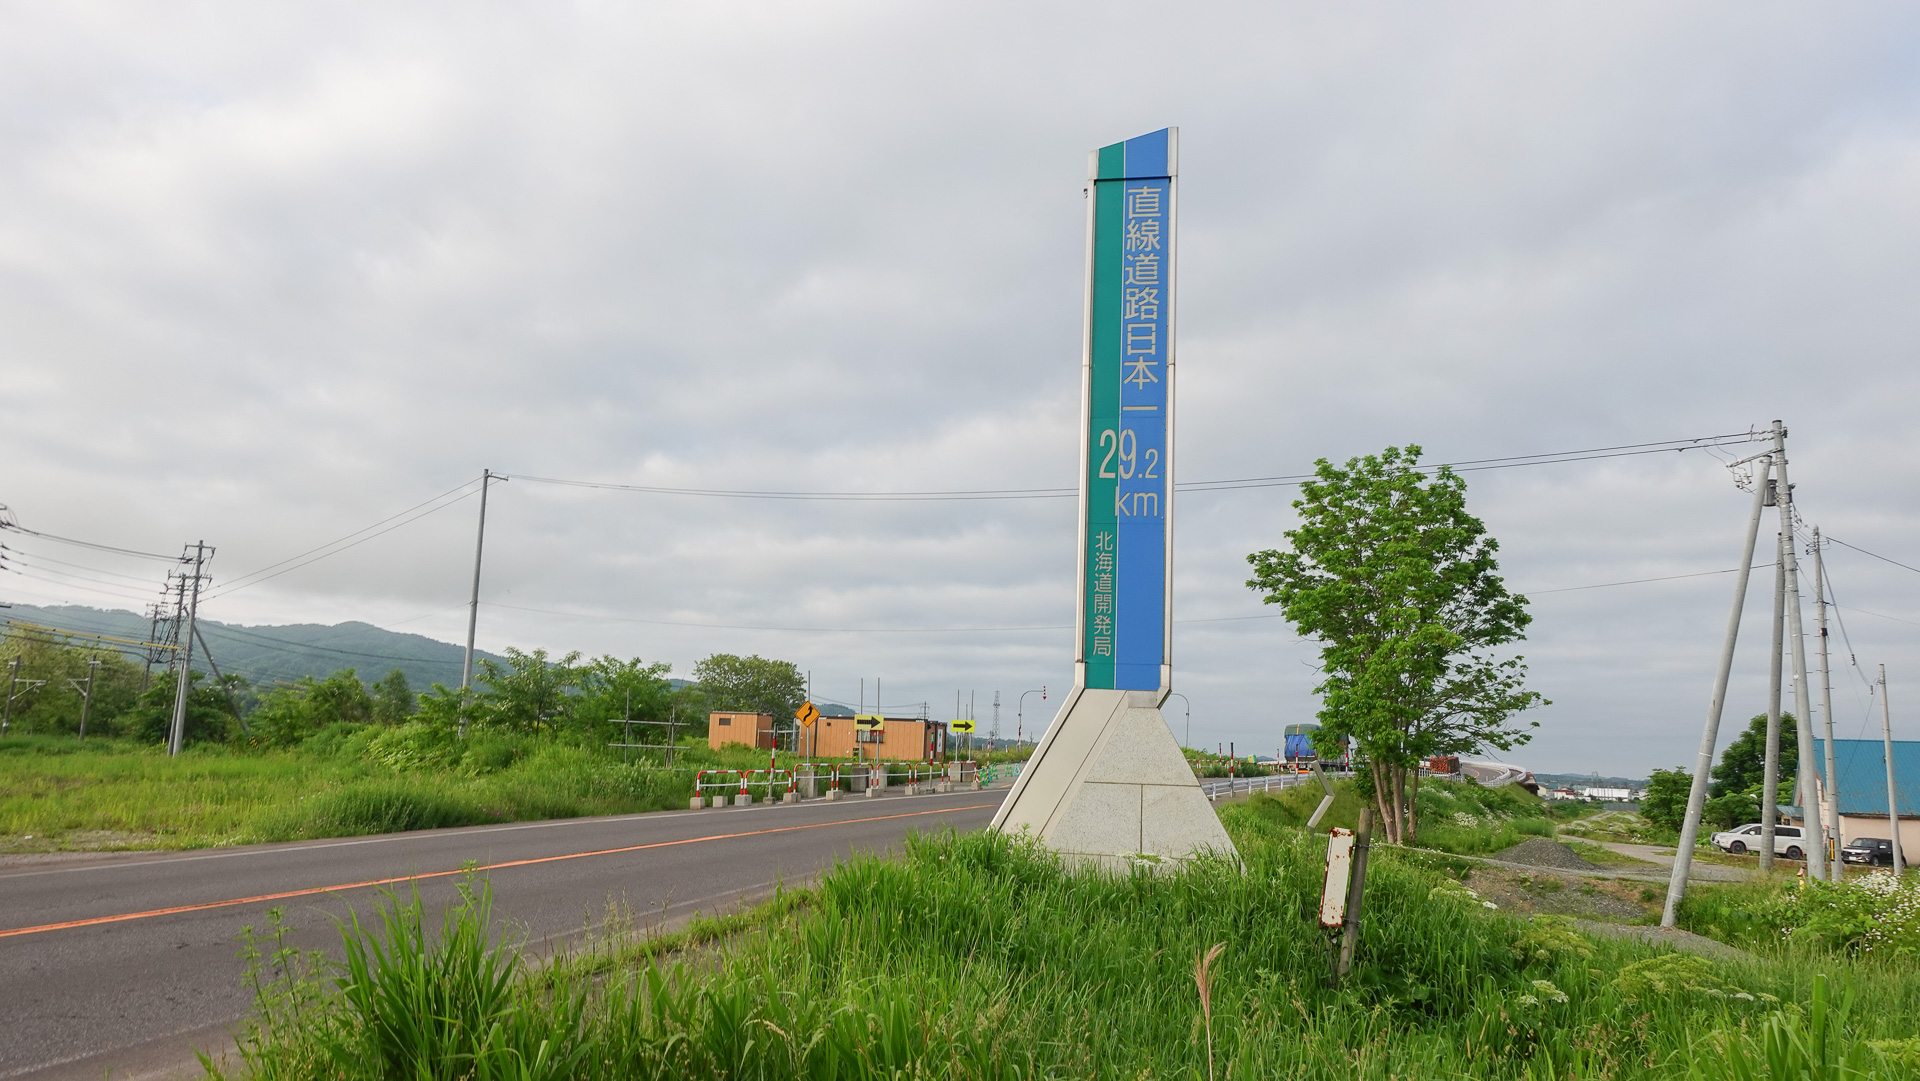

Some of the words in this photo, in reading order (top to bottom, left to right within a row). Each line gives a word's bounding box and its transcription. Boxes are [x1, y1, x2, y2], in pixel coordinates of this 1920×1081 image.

[1122, 185, 1162, 410] 直線道路日本一
[1099, 429, 1158, 479] 29.2
[1114, 486, 1158, 517] km
[1093, 531, 1114, 657] 北海道開発局
